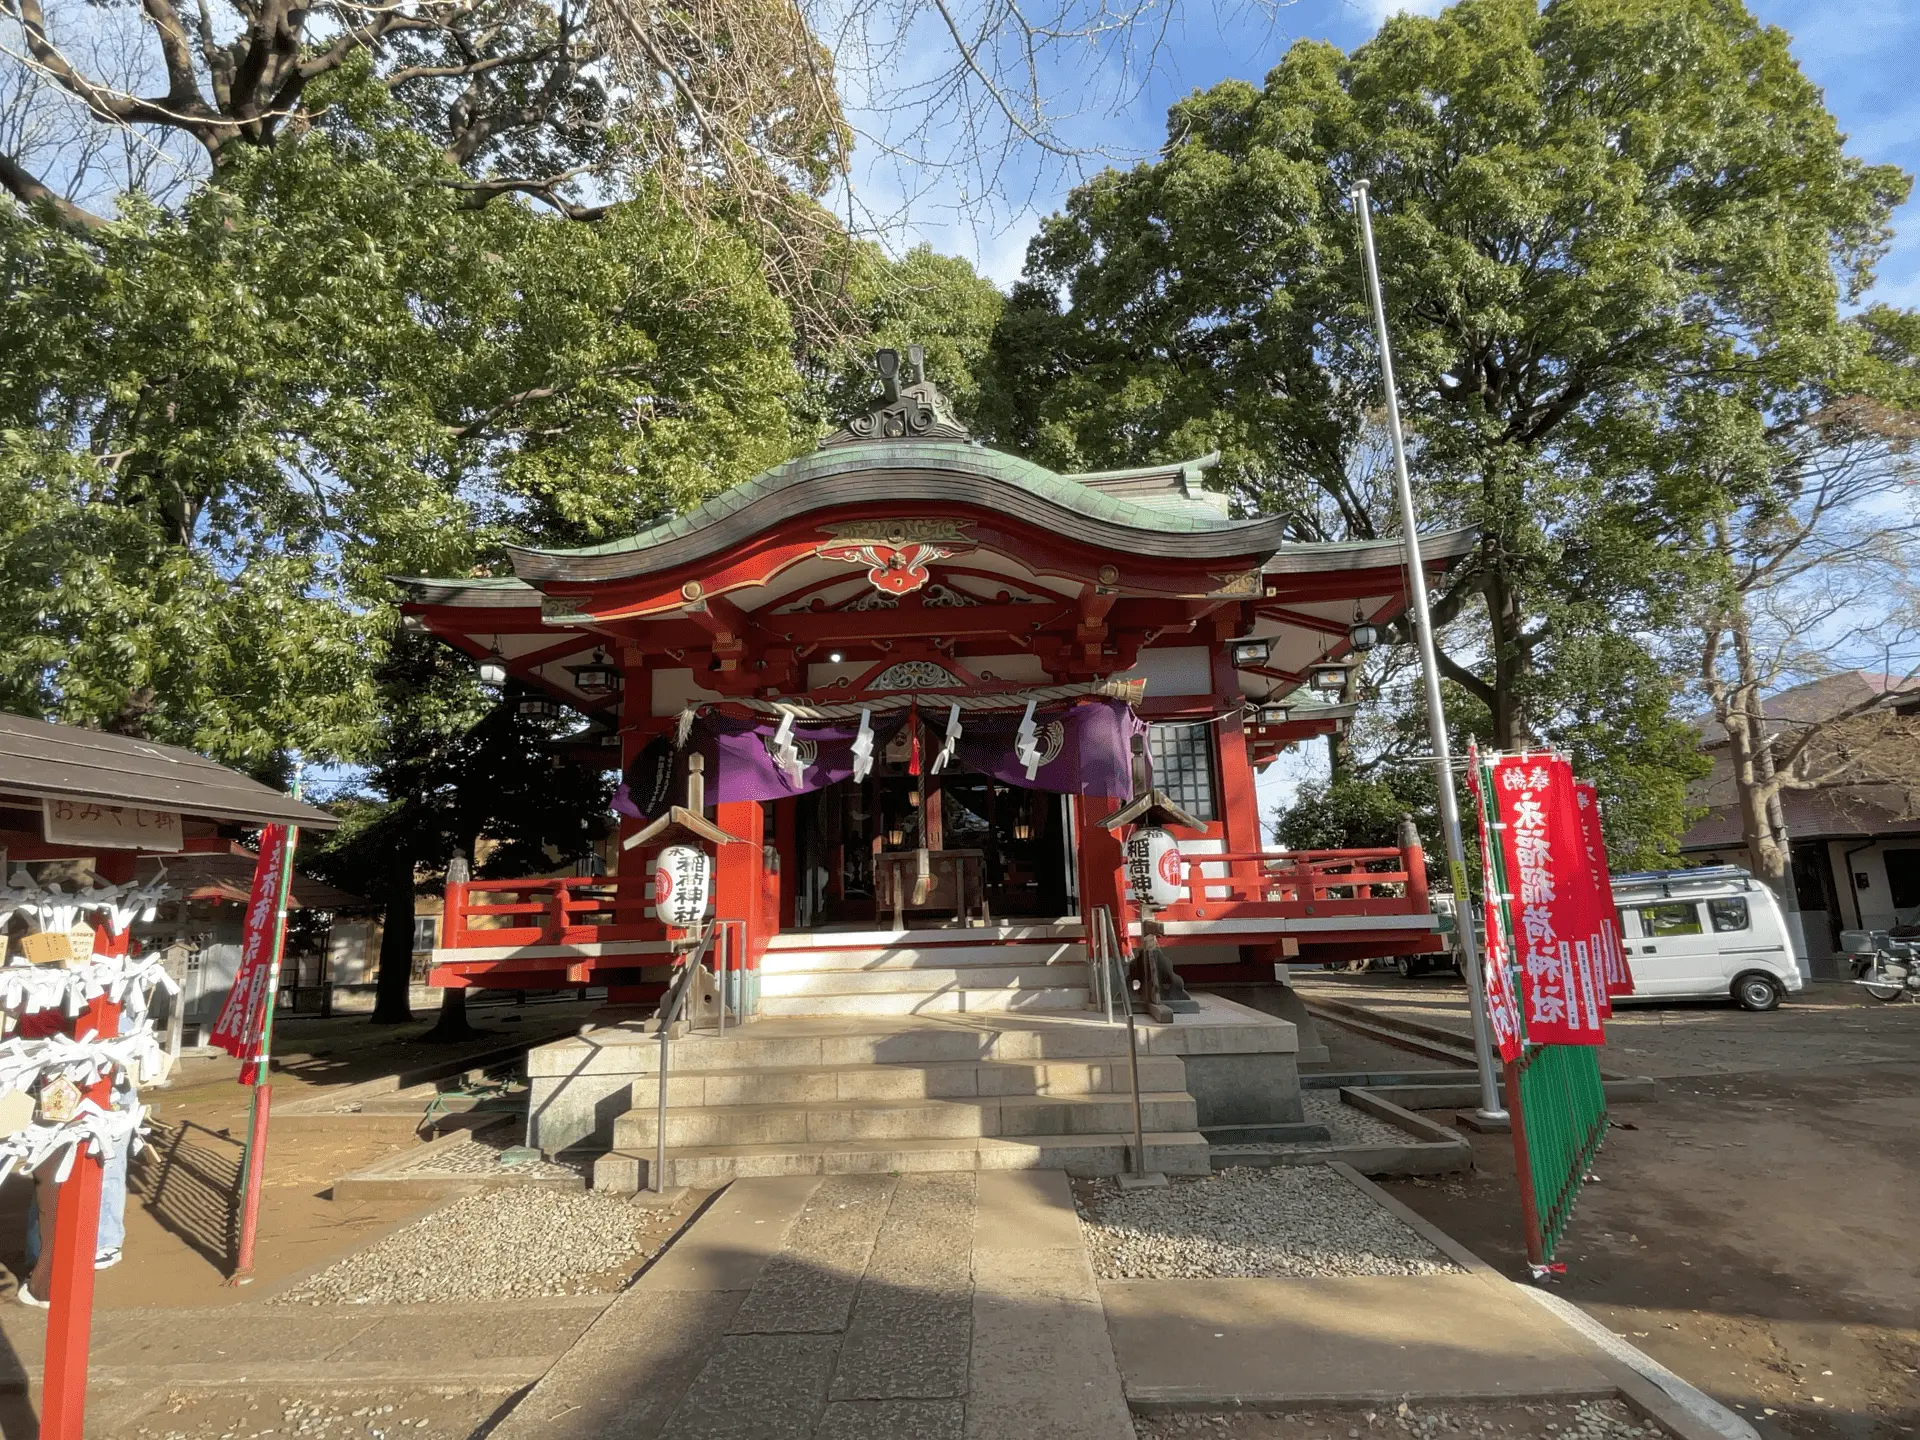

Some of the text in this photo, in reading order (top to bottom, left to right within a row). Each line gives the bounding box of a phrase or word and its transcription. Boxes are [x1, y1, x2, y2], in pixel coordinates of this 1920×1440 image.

[673, 854, 706, 923] 稲荷神社
[1127, 838, 1160, 905] 稲荷神社
